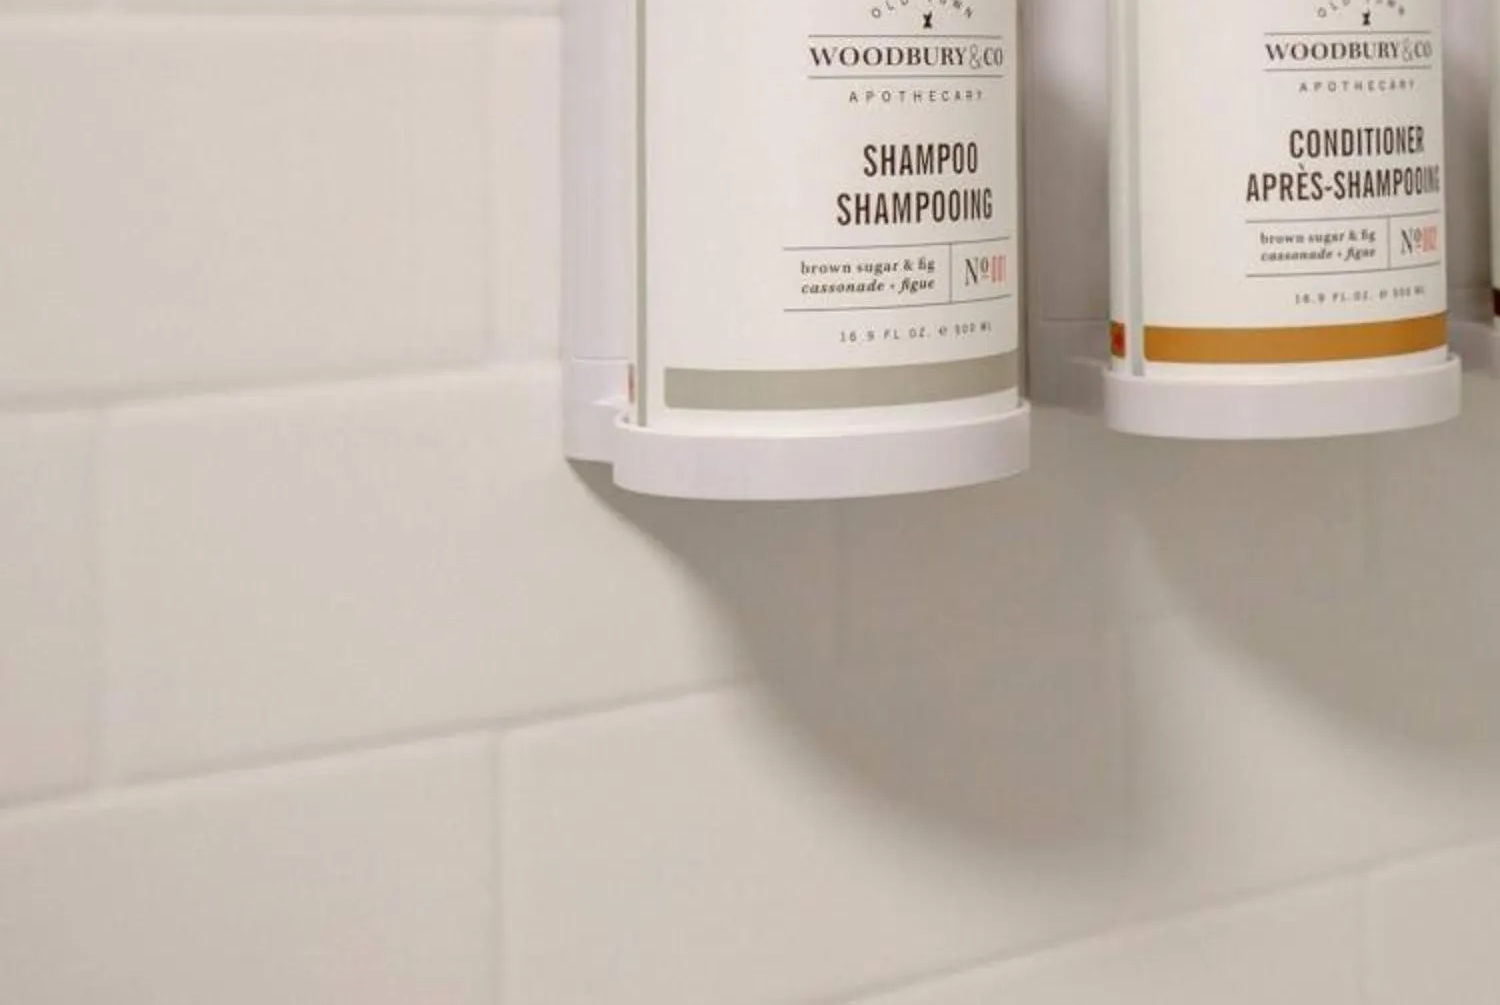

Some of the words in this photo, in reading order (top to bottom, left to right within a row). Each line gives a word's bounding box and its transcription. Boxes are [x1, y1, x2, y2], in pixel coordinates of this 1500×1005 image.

[848, 90, 983, 103] APOTHECARY
[1298, 79, 1416, 93] APOTHECARY
[1289, 124, 1425, 159] CONDITIONER
[863, 141, 978, 177] SHAMPOO
[1245, 162, 1440, 203] APRÈS-SHAMPOOING
[836, 187, 993, 226] SHAMPOOING
[1260, 231, 1305, 245] brown
[1307, 231, 1345, 245] sugar
[800, 260, 851, 275] brown
[856, 262, 898, 277] sugar
[903, 259, 913, 272] &
[917, 256, 936, 274] fig
[801, 278, 885, 294] cassonade
[897, 277, 935, 294] figue
